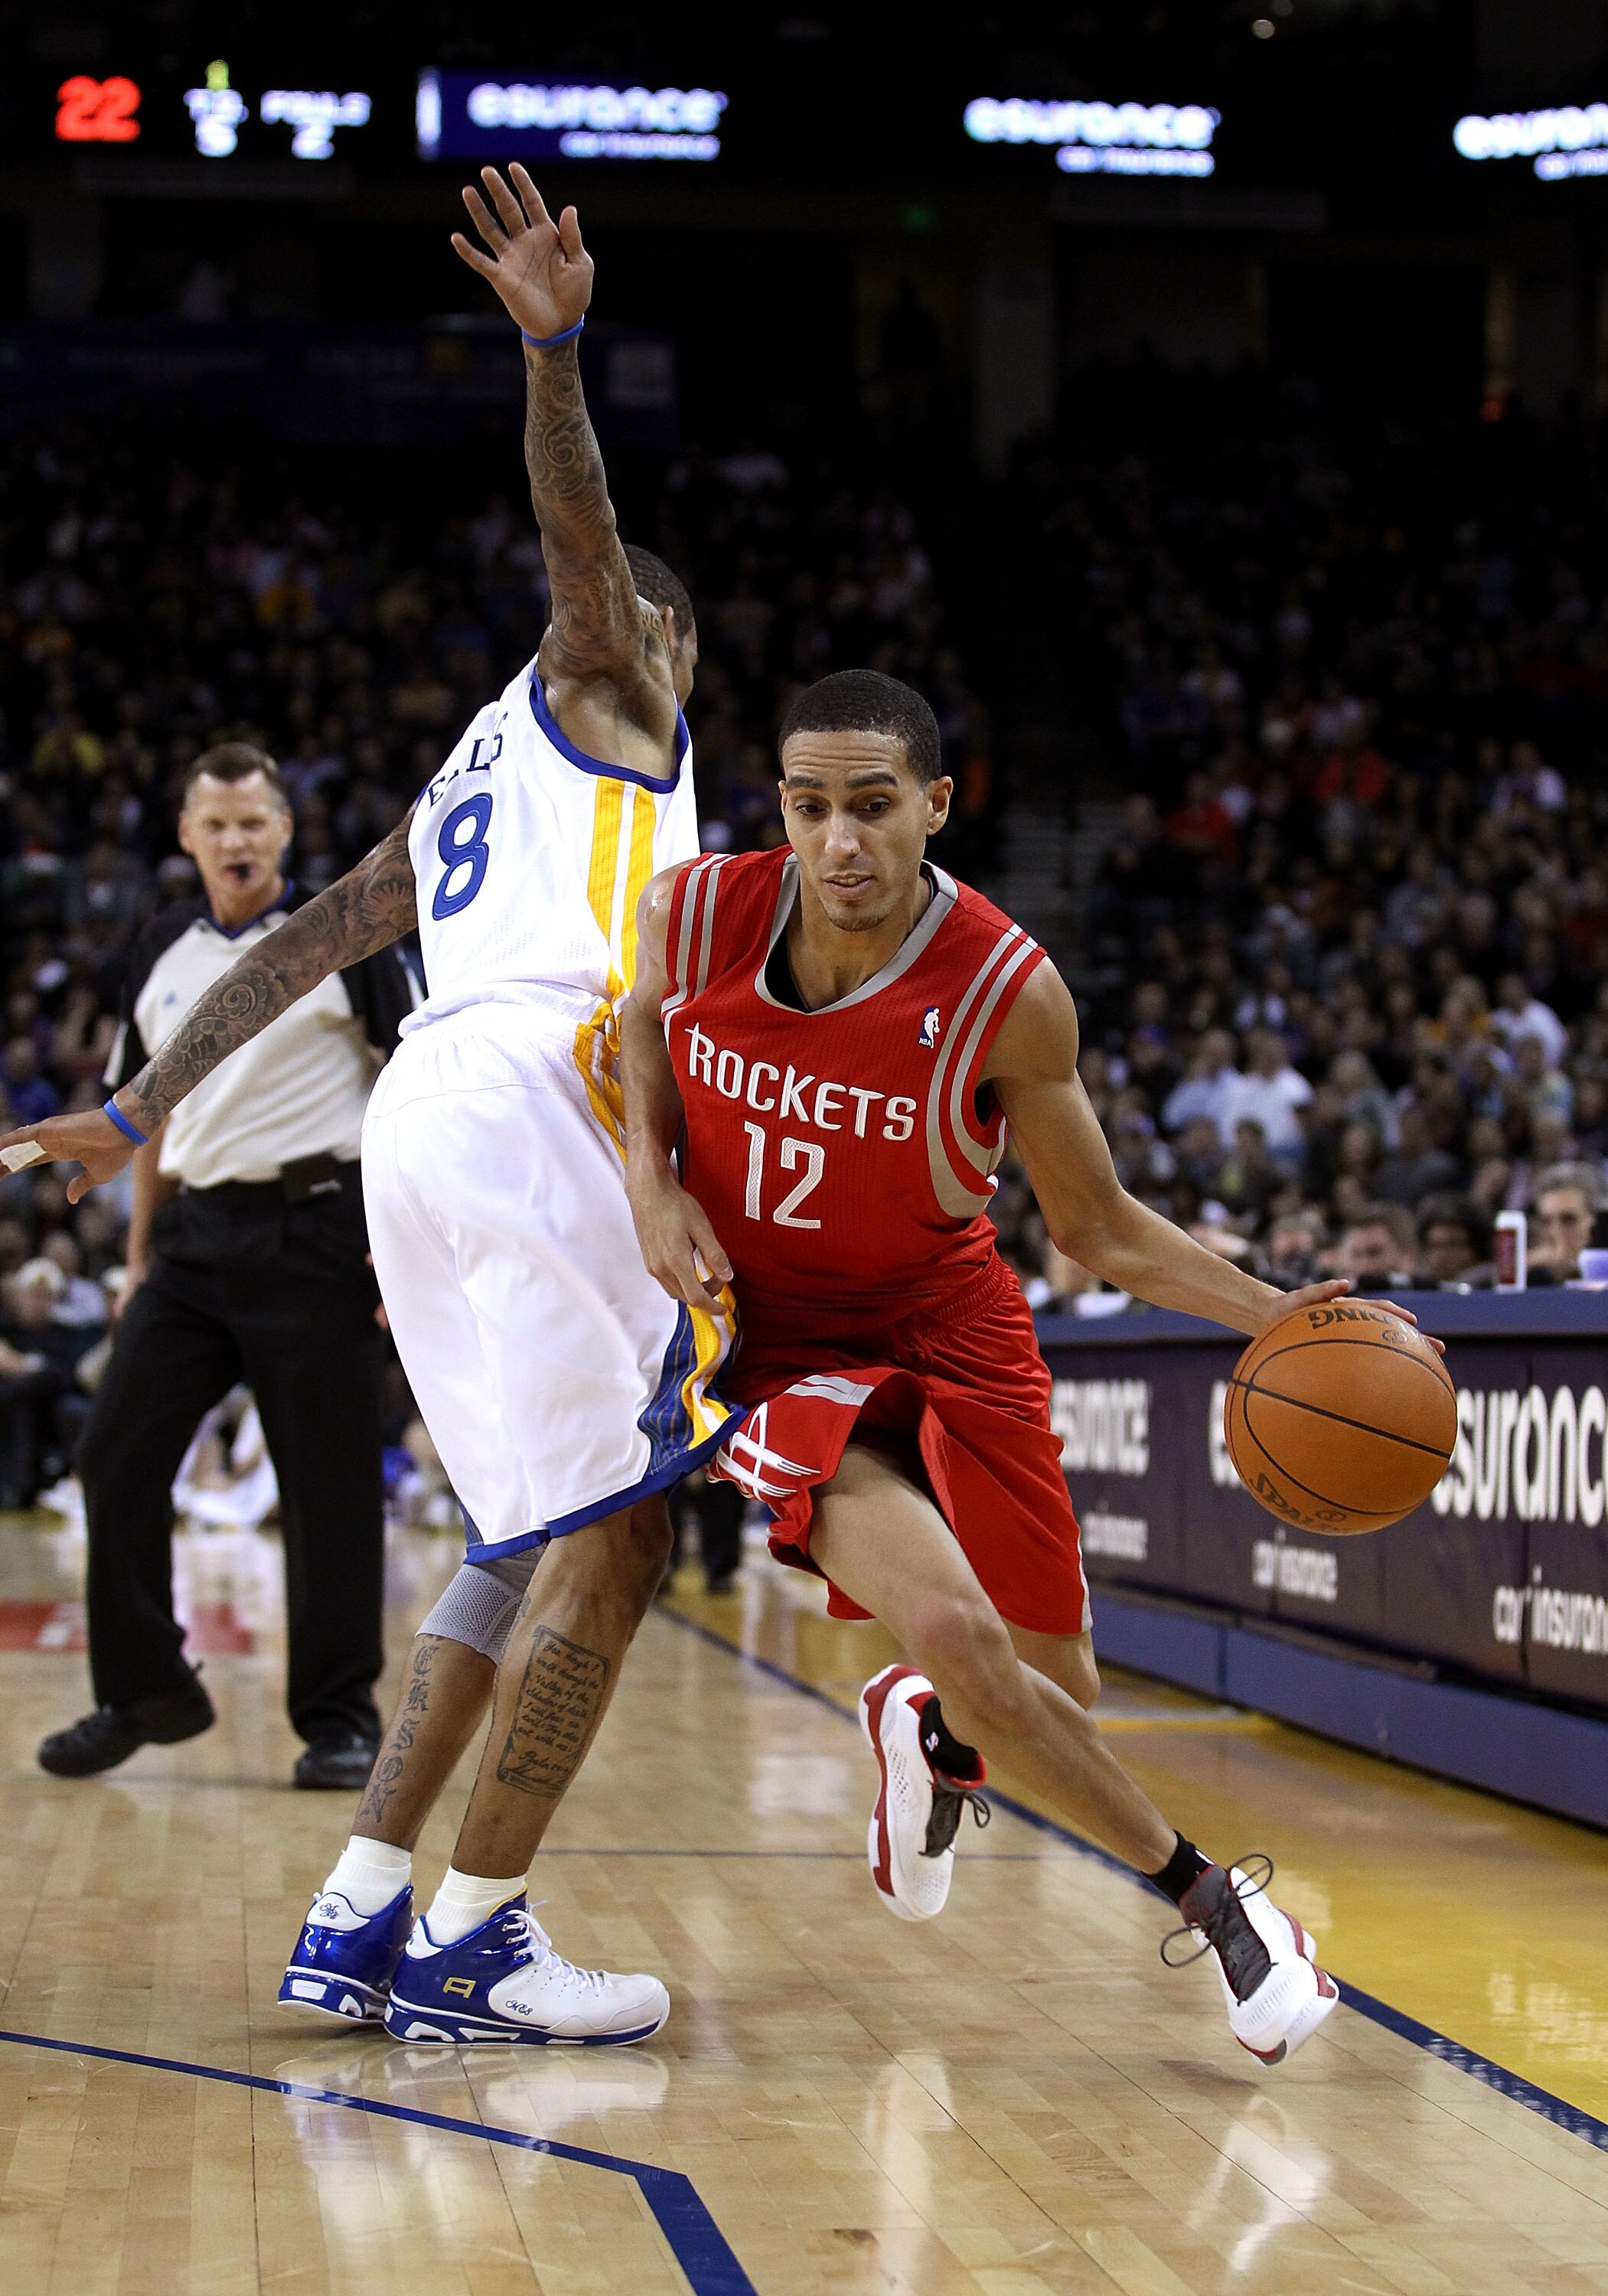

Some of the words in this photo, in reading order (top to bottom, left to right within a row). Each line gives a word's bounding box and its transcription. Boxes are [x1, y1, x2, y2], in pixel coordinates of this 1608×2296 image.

[55, 75, 141, 142] 22
[432, 792, 494, 921] 8
[684, 1022, 918, 1141] ROCKETS
[918, 1037, 931, 1046] NBA
[743, 1120, 826, 1229] 12
[1431, 1385, 1608, 1528] suranc
